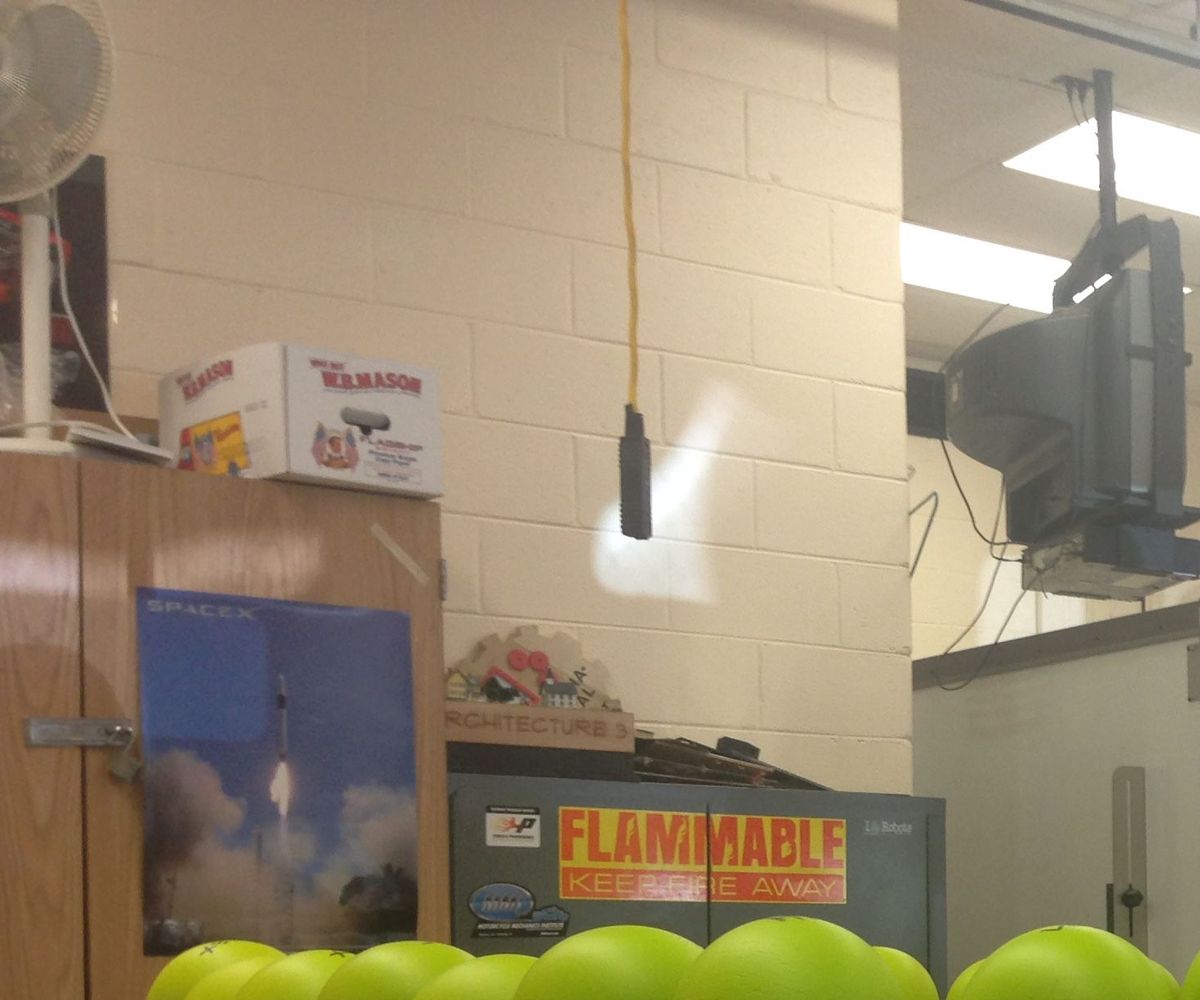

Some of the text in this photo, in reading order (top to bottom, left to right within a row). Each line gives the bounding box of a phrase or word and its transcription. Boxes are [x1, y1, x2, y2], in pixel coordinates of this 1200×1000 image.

[147, 600, 256, 619] SPACEX
[445, 711, 607, 738] RCHITECTURE
[561, 809, 845, 868] FLAMMABLE
[568, 872, 837, 898] KEEP FIRE AWAY
